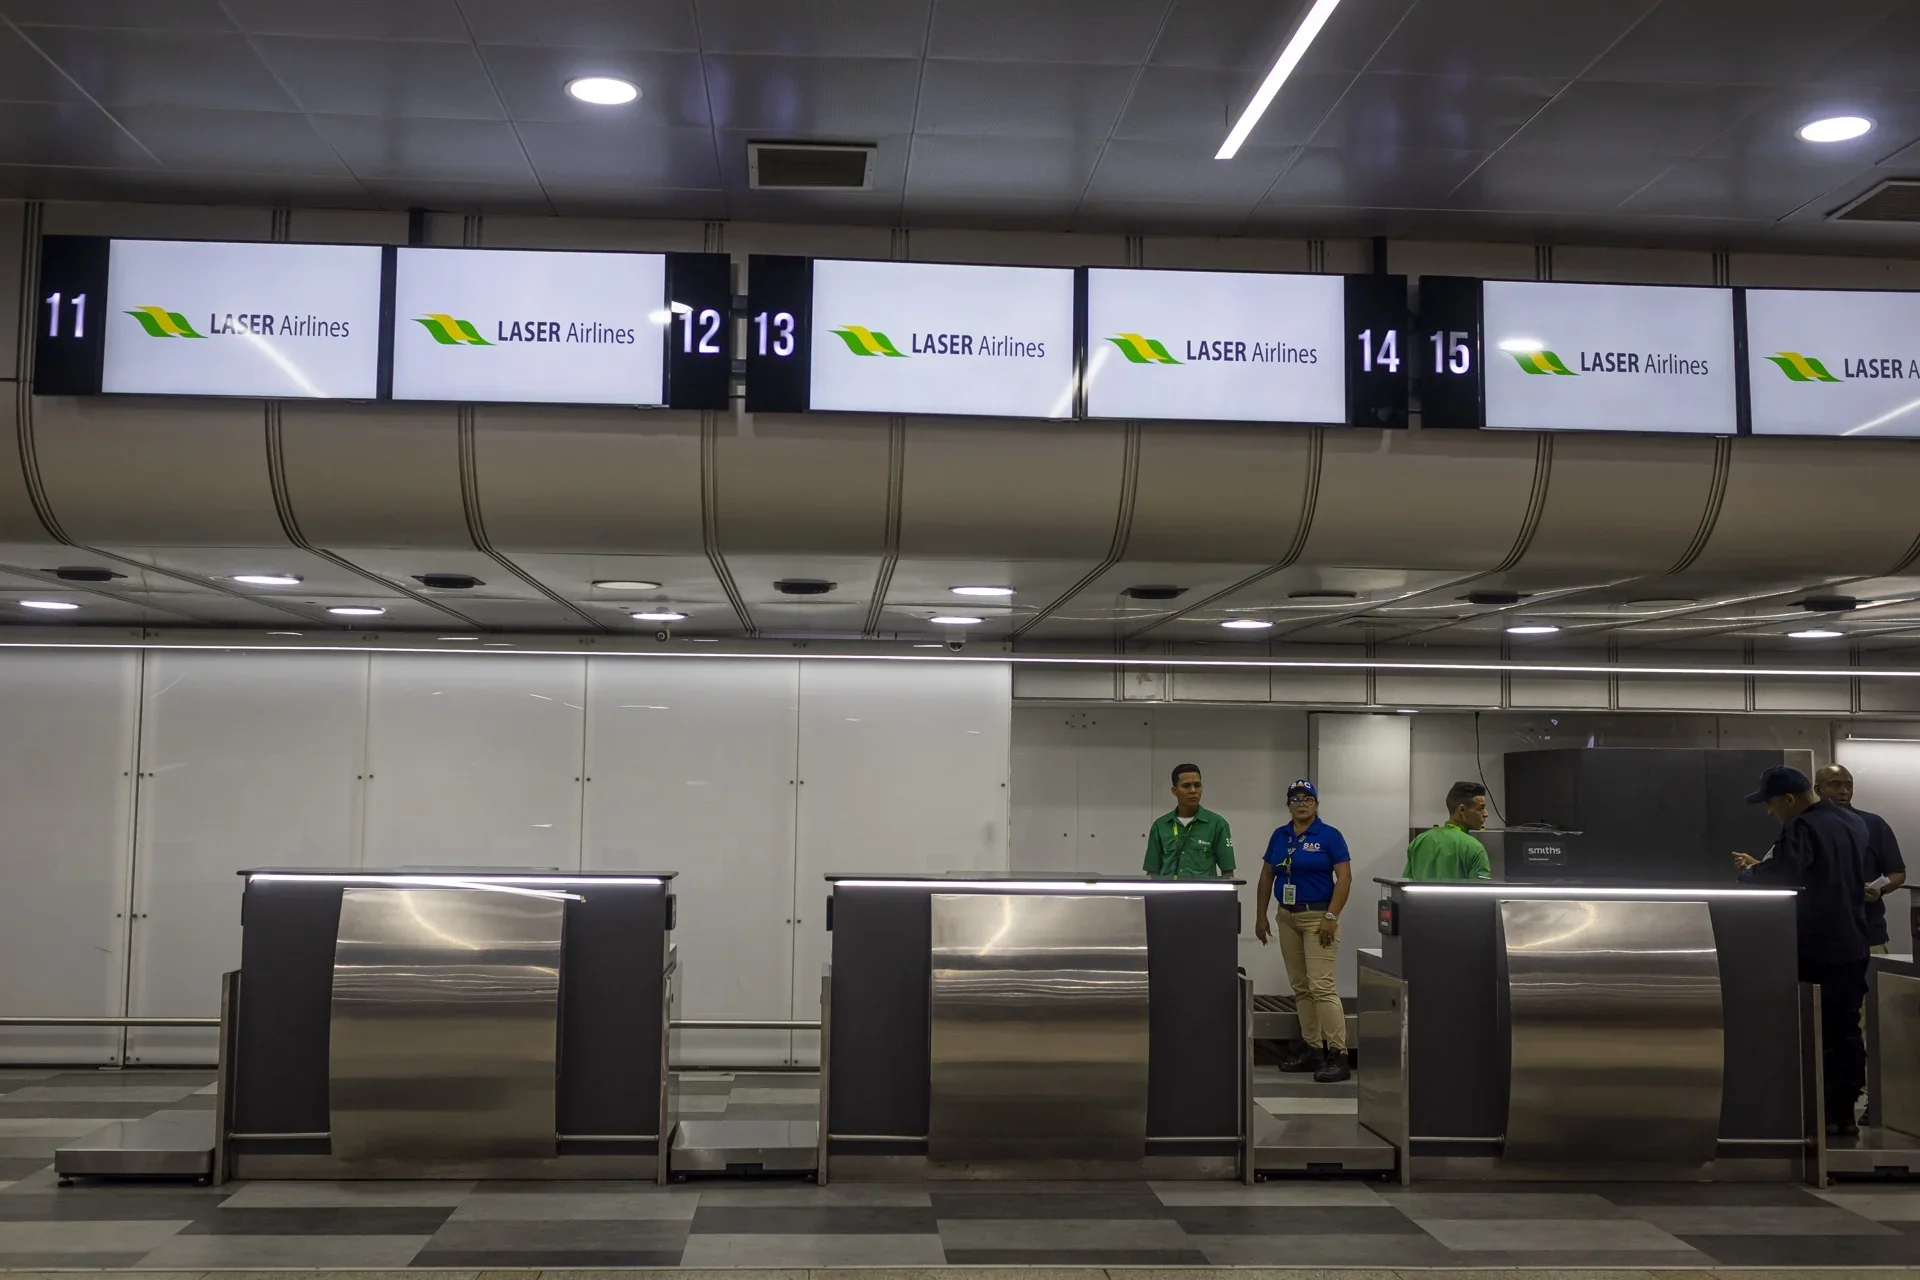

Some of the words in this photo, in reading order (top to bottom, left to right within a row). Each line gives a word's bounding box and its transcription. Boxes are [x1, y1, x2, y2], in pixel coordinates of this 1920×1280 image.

[46, 292, 86, 338] 11
[210, 312, 274, 336] LASER
[279, 314, 350, 338] Airlines
[498, 320, 561, 343] LASER
[566, 322, 635, 345] Airlines
[679, 309, 721, 354] 12
[754, 311, 795, 356] 13
[912, 333, 973, 355] LASER
[978, 335, 1045, 358] Airlines
[1186, 340, 1247, 362] LASER
[1251, 342, 1317, 364] Airlines
[1358, 329, 1400, 373] 14
[1429, 330, 1470, 375] 15
[1581, 351, 1640, 373] LASER
[1644, 353, 1709, 375] Airlines
[1844, 358, 1904, 379] LASER
[1290, 780, 1311, 789] SAC
[1303, 842, 1321, 850] SAC
[1528, 846, 1561, 855] smiths
